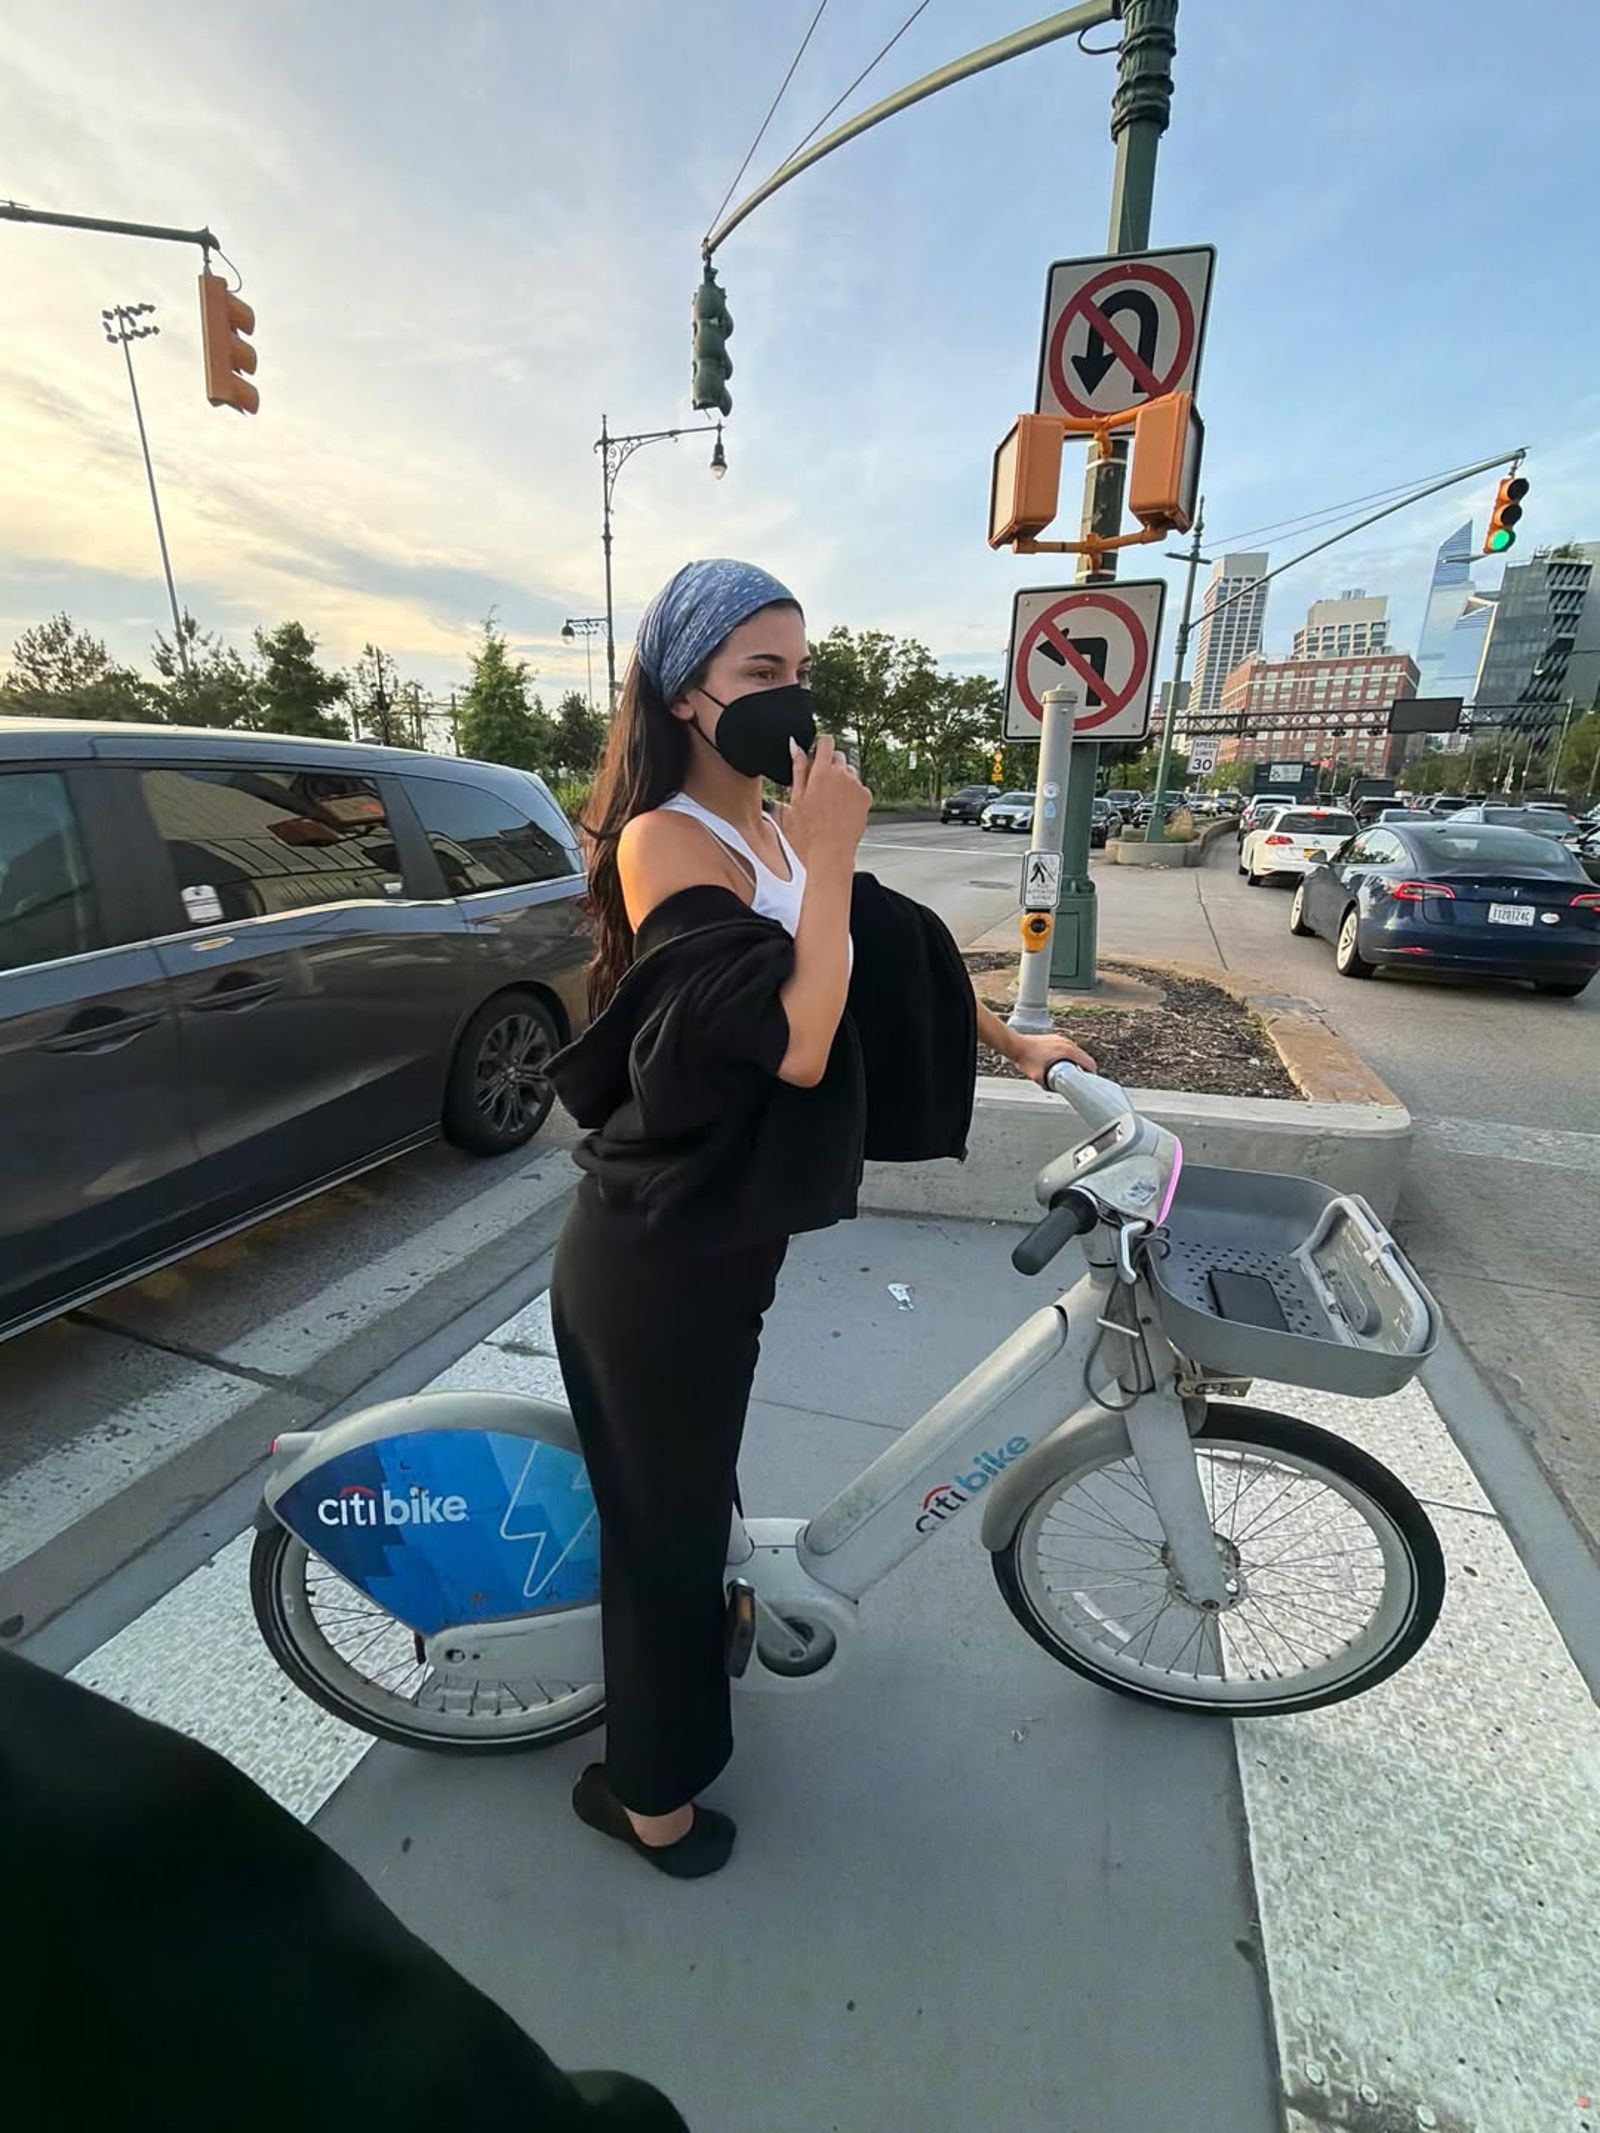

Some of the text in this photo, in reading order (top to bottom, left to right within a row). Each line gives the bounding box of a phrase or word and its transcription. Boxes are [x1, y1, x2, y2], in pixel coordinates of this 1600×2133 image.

[1192, 758, 1213, 771] 30
[915, 1436, 1030, 1533] citi bike
[317, 1487, 468, 1526] citi bike
